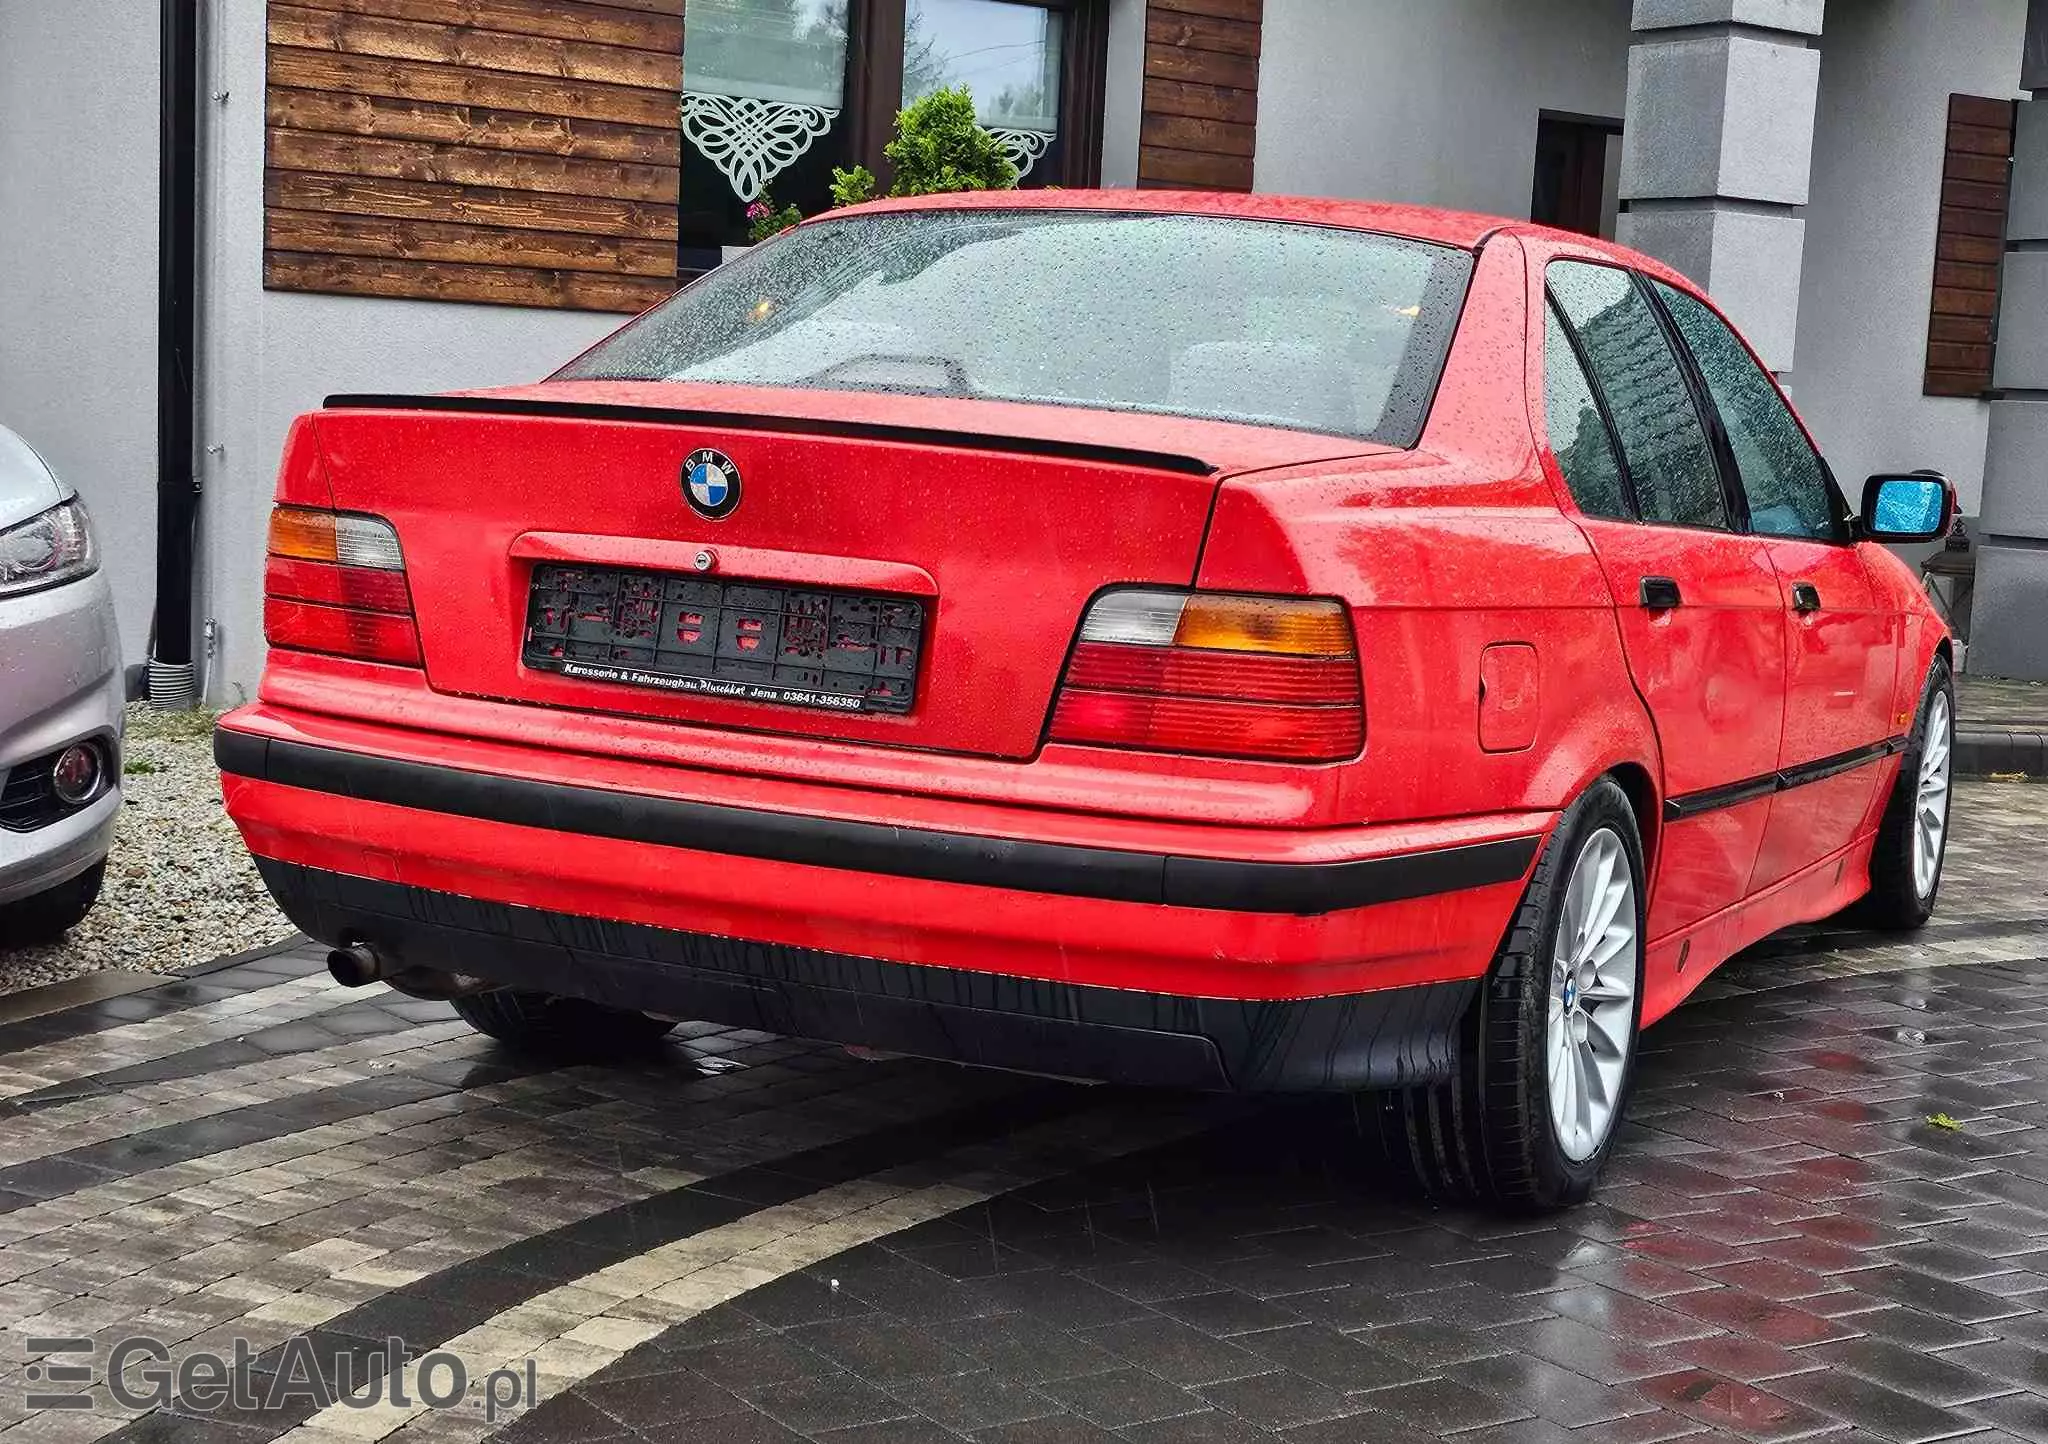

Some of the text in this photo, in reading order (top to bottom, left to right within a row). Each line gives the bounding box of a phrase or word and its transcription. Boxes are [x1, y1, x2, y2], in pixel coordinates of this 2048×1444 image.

[685, 452, 735, 475] BMW
[621, 671, 629, 681] &
[631, 672, 697, 689] Fahrzeugbau
[751, 684, 777, 699] Jena
